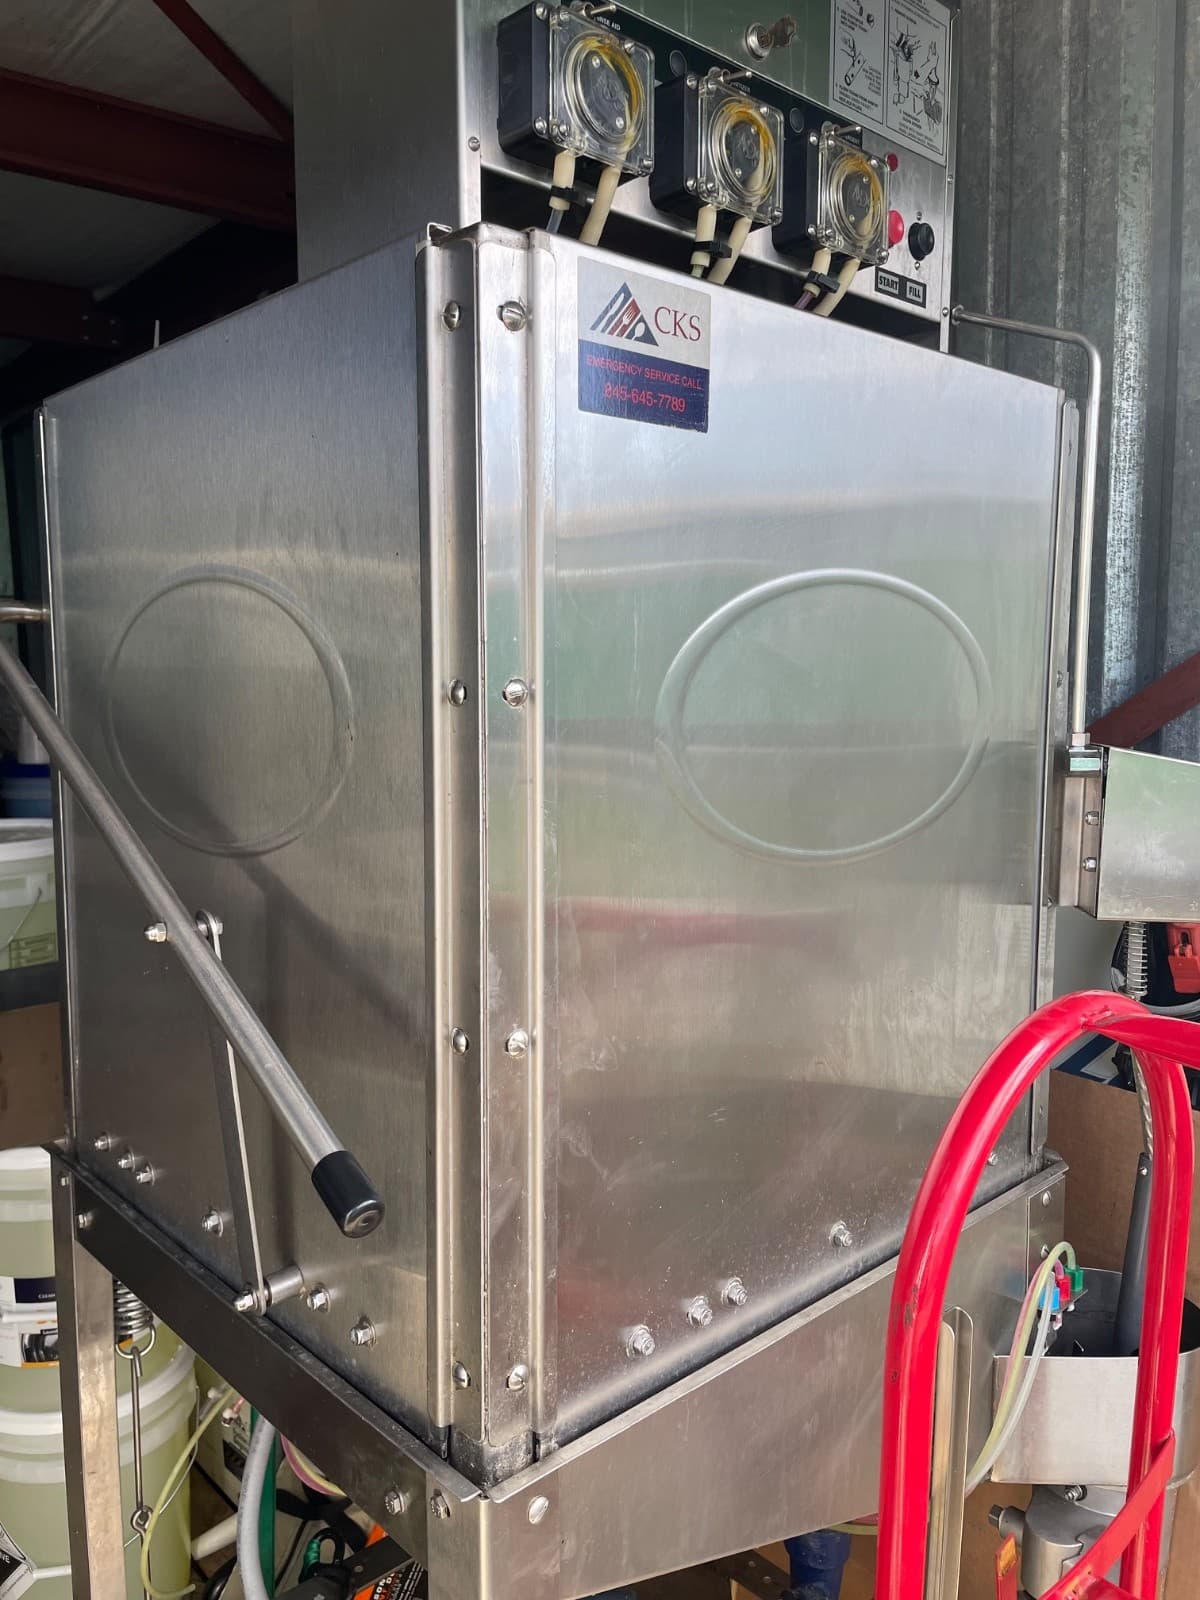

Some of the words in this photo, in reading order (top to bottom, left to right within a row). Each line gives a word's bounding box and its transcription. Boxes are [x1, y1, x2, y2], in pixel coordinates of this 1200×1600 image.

[611, 21, 621, 31] AID
[879, 276, 898, 290] START
[909, 286, 921, 298] FILL
[654, 306, 701, 342] CKS
[586, 355, 642, 376] EMERGENCY
[644, 367, 680, 385] SERVICE
[681, 376, 702, 390] CALL
[604, 382, 686, 413] 845-645-7789
